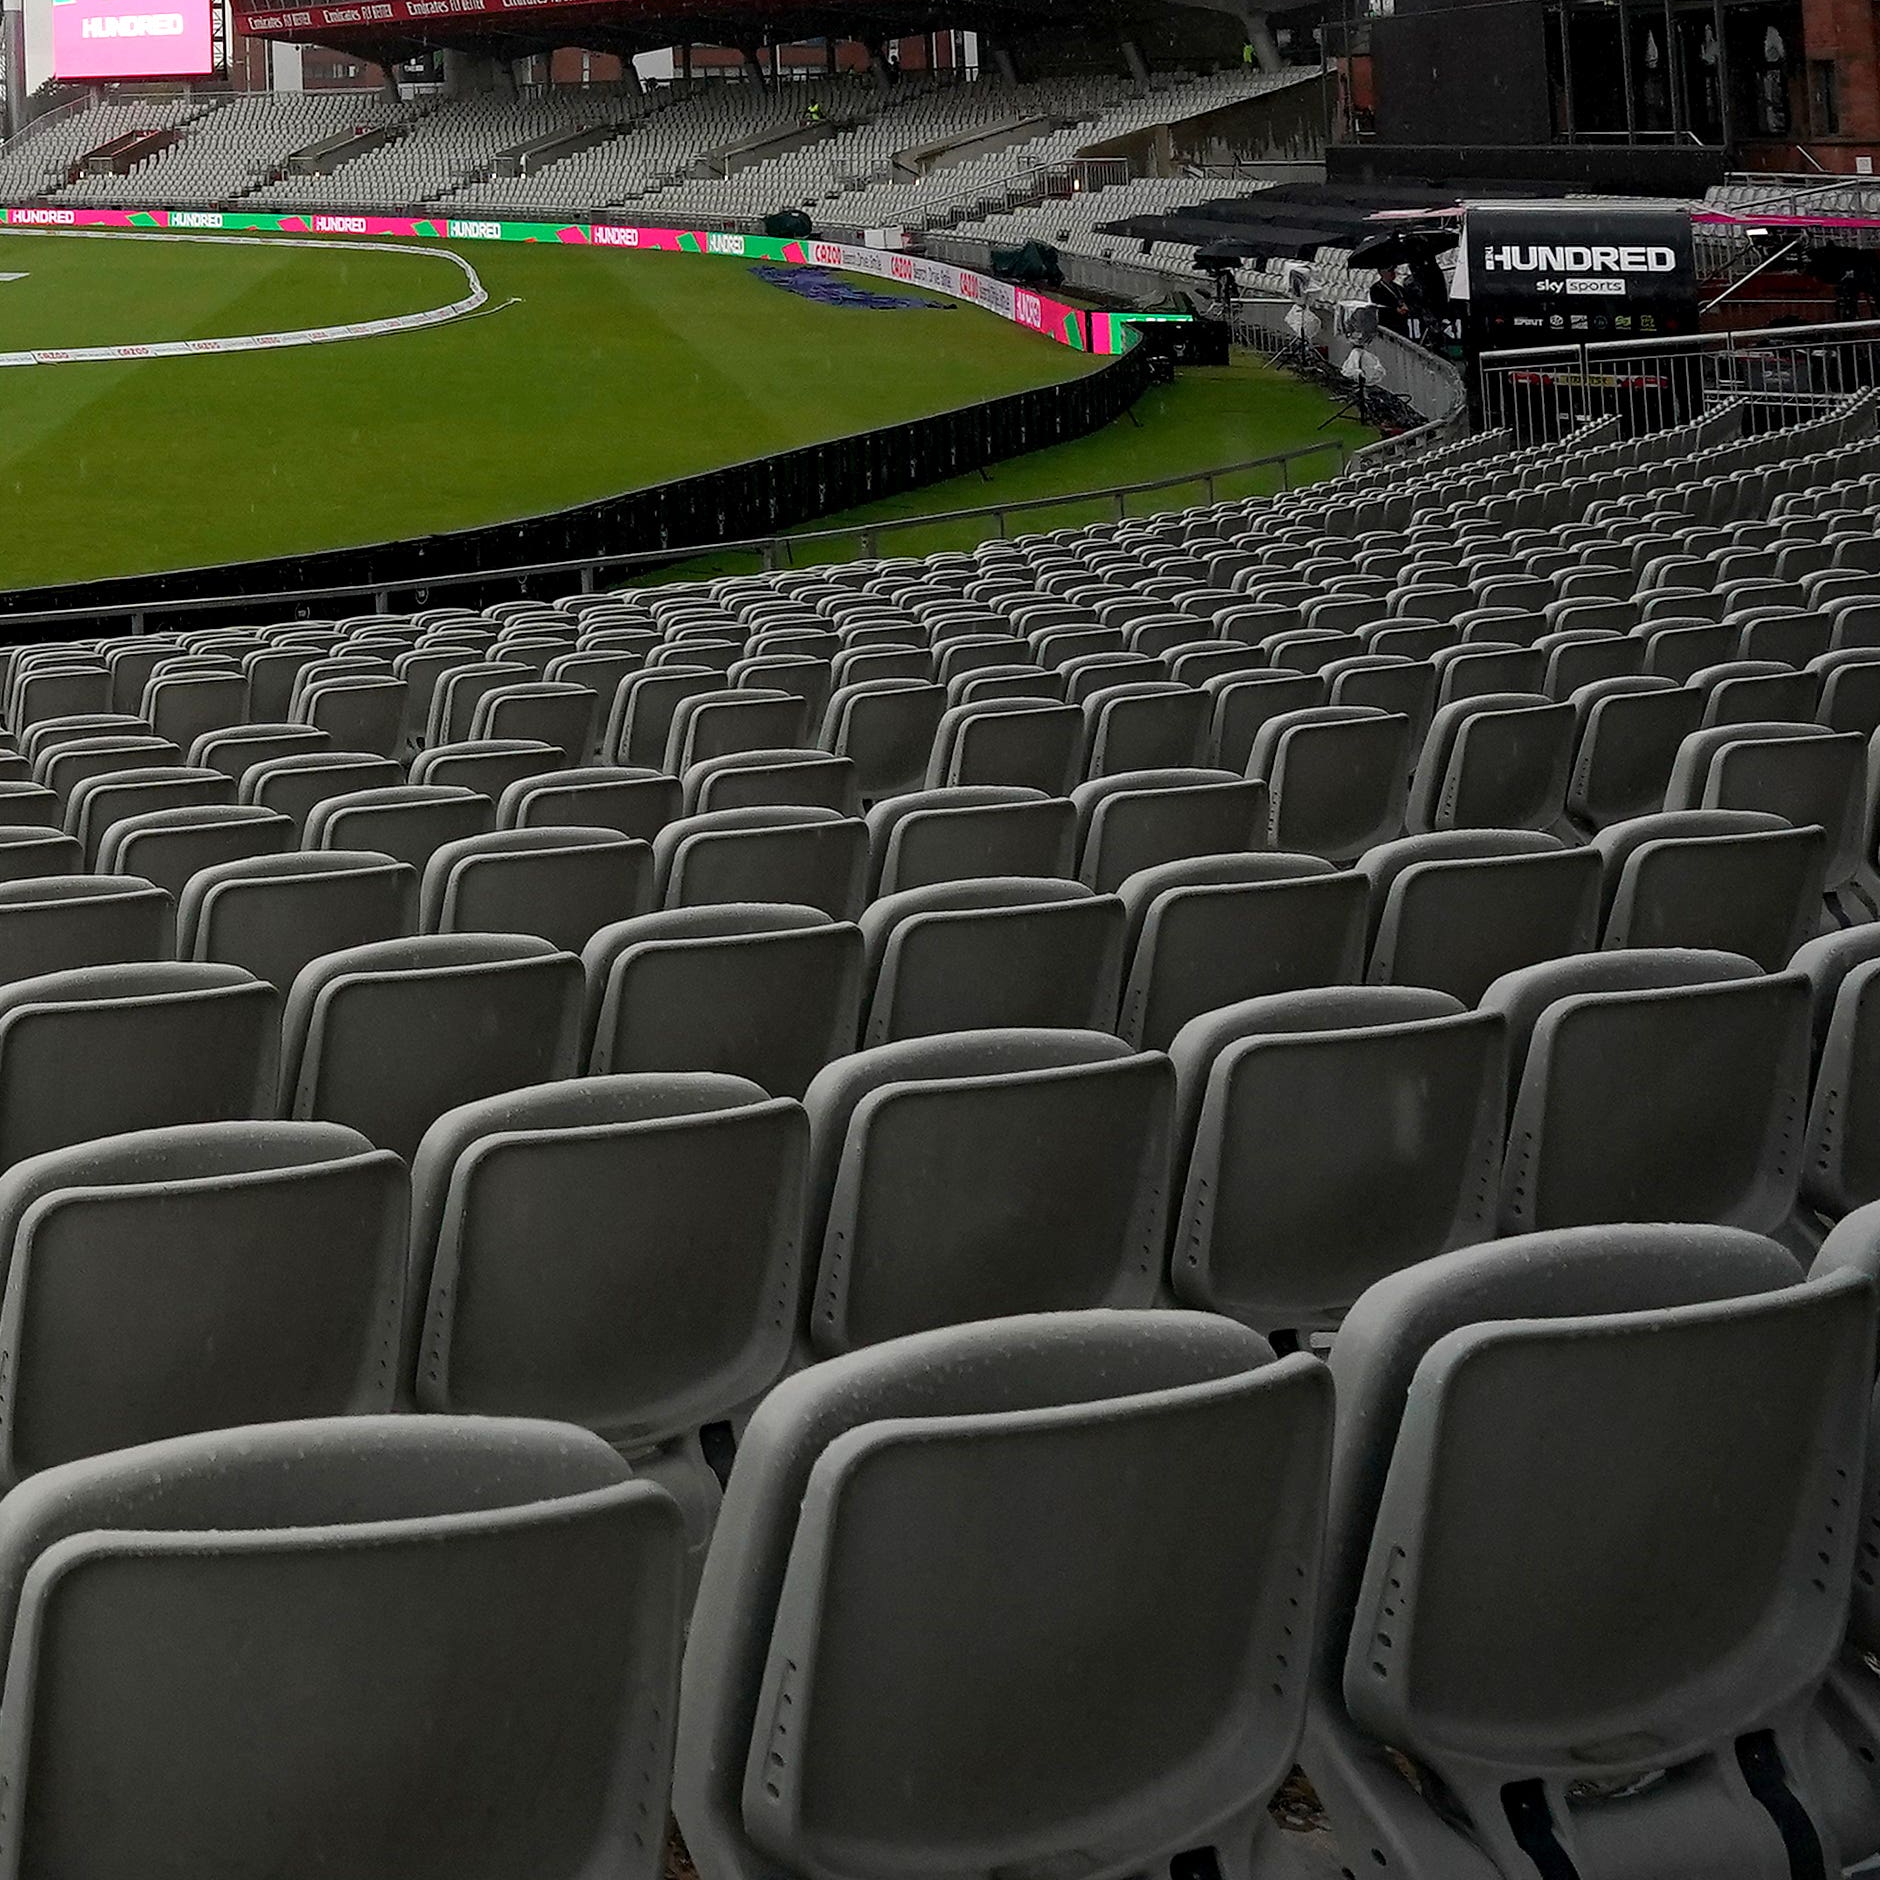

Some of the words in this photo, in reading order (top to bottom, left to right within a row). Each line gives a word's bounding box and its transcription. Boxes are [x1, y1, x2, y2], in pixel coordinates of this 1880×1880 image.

[82, 13, 184, 38] HUNDRED
[13, 209, 75, 225] HUNDRED
[171, 212, 223, 228] HUNDRED
[316, 217, 366, 233] HUNDRED
[450, 221, 501, 238] HUNDRED
[1485, 245, 1676, 272] HUNDRED
[1536, 279, 1564, 294] sky
[1569, 280, 1623, 293] sports
